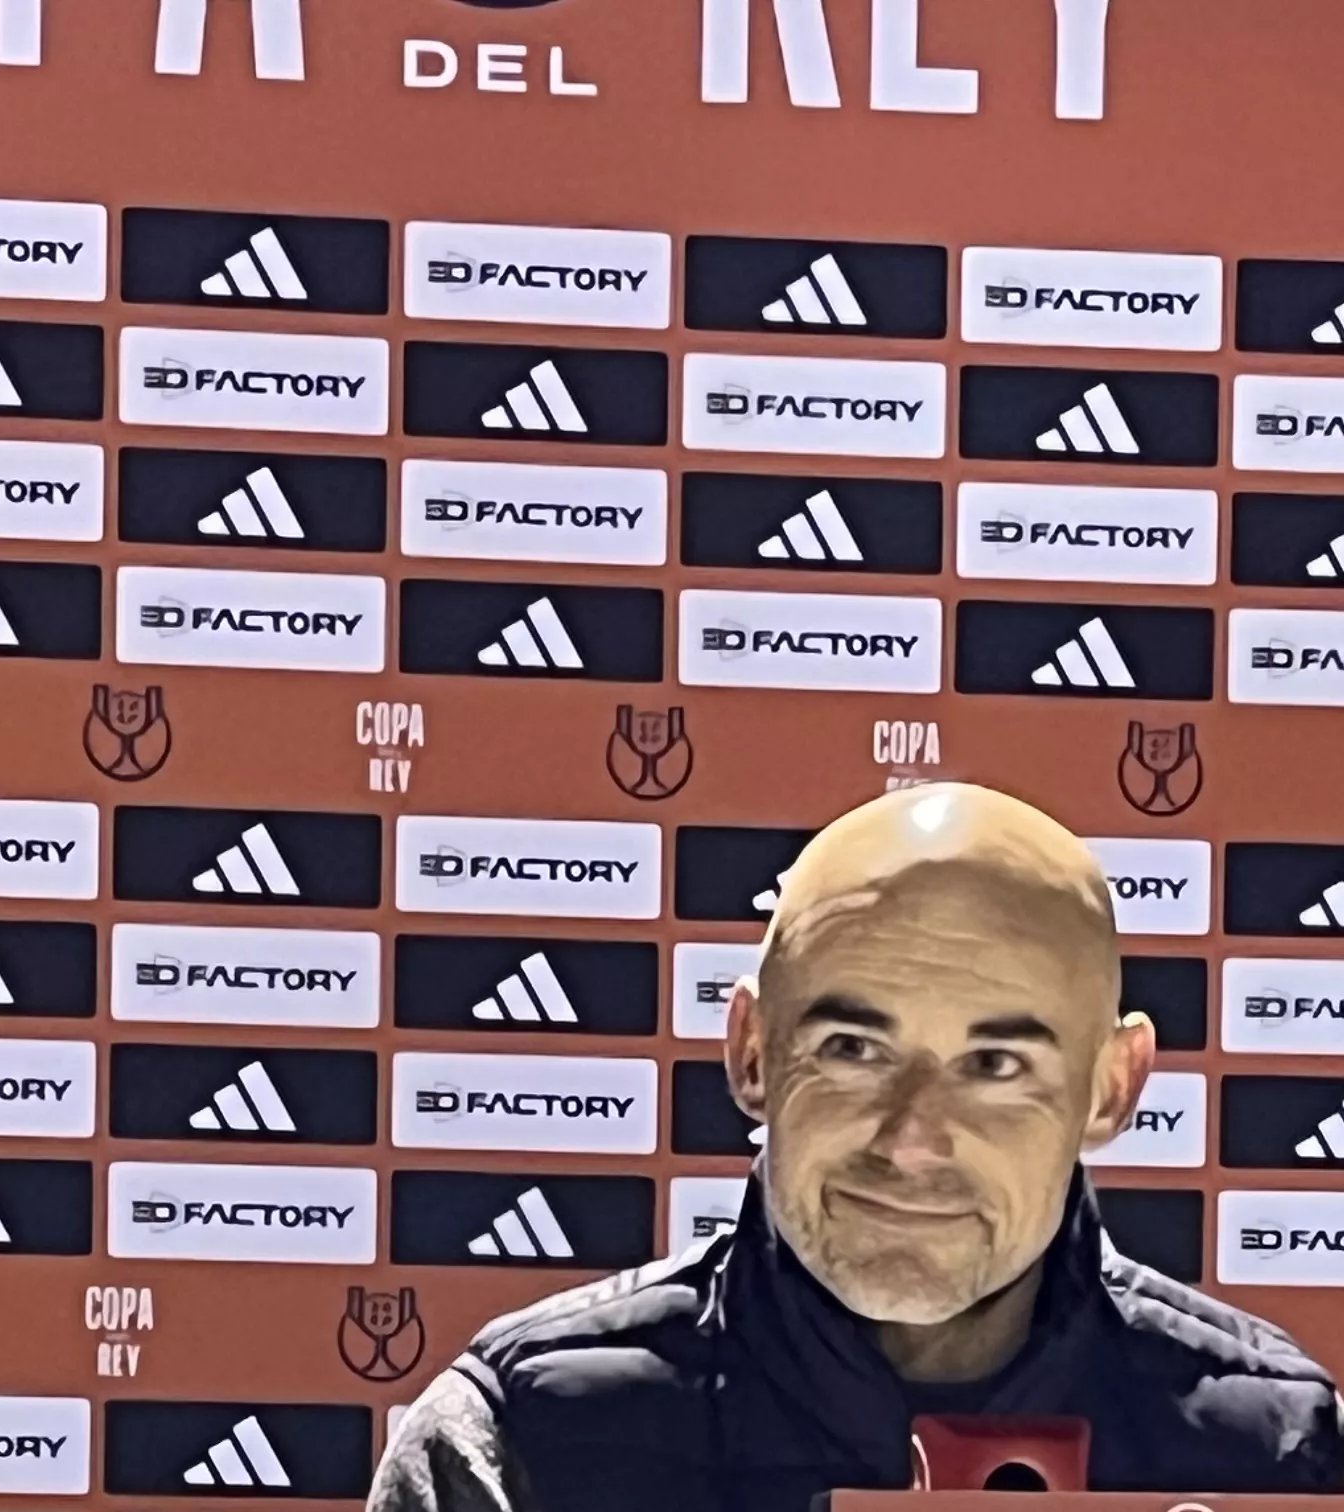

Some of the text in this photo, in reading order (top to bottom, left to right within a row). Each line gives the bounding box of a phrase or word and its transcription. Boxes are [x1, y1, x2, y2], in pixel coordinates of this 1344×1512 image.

[404, 40, 598, 97] DEL
[479, 263, 647, 292] FACTORY
[1035, 288, 1199, 315] FACTORY
[195, 369, 365, 398] FACTORY
[757, 395, 923, 422] FACTORY
[475, 501, 643, 529] FACTORY
[1030, 523, 1194, 549] FACTORY
[192, 608, 363, 636] FACTORY
[753, 631, 918, 657] FACTORY
[357, 702, 424, 746] COPA
[874, 720, 940, 765] COPA
[470, 856, 638, 883] FACTORY
[187, 965, 357, 991] FACTORY
[467, 1092, 634, 1118] FACTORY
[184, 1203, 354, 1228] FACTORY
[86, 1287, 153, 1330] COPA
